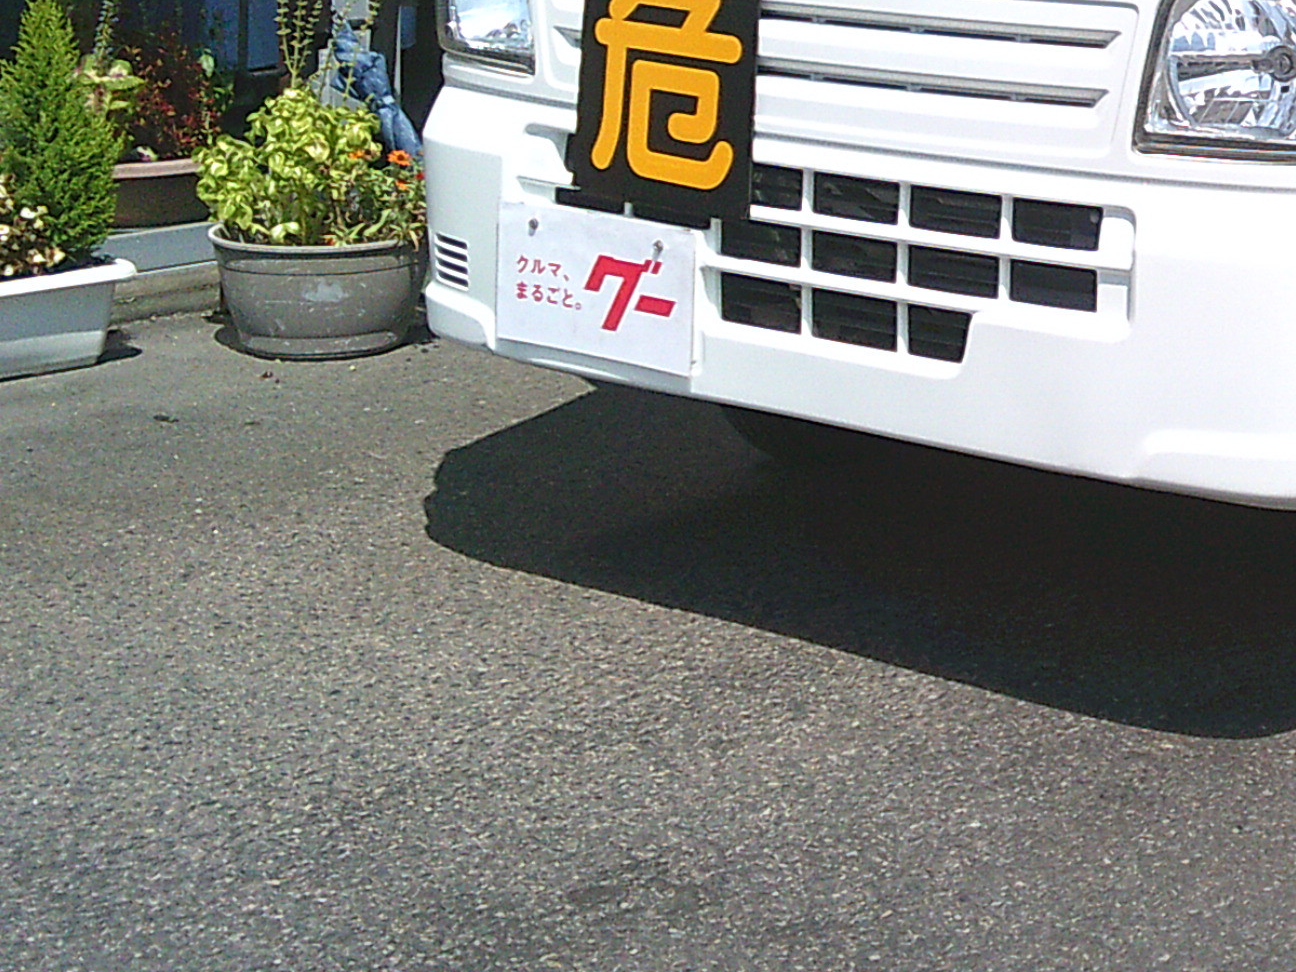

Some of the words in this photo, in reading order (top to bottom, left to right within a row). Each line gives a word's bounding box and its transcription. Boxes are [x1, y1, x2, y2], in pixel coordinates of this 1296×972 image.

[516, 281, 582, 311] まるごと。
[583, 254, 677, 332] グー
